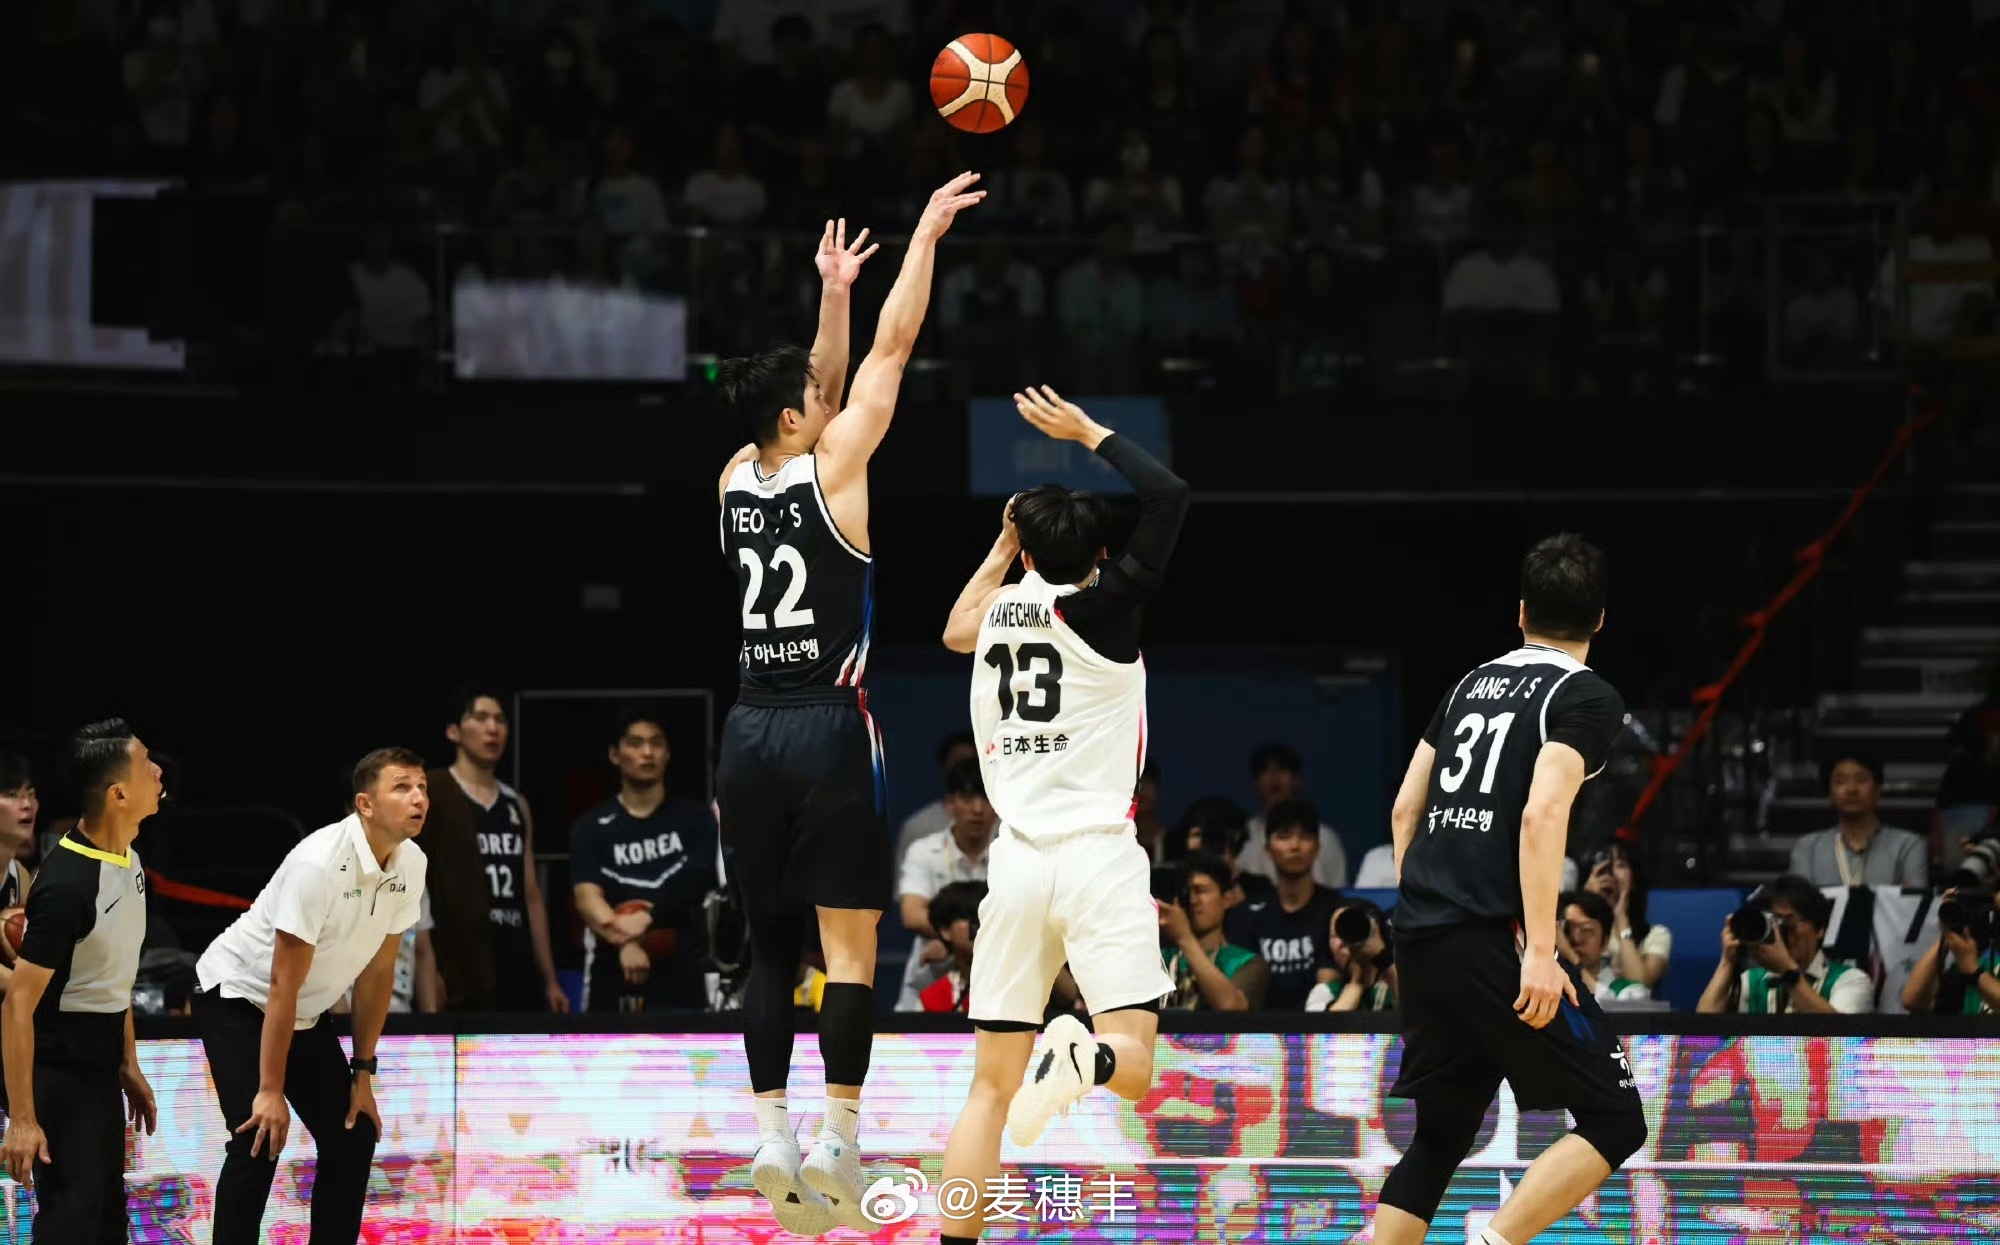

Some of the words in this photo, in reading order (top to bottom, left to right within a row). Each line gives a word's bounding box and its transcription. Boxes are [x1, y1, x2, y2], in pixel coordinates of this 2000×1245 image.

[731, 507, 765, 534] YEO
[789, 502, 802, 528] S
[738, 543, 815, 629] 22
[988, 602, 1053, 629] KANECHIKA
[753, 638, 820, 665] 하나은행
[984, 642, 1063, 722] 13
[1466, 676, 1511, 700] JANG
[1523, 677, 1543, 699] S
[1003, 733, 1070, 755] 日本生命
[1439, 711, 1516, 794] 31
[476, 832, 524, 856] OREA
[613, 831, 683, 866] KOREA
[484, 863, 514, 898] 12
[1902, 888, 1935, 943] 7
